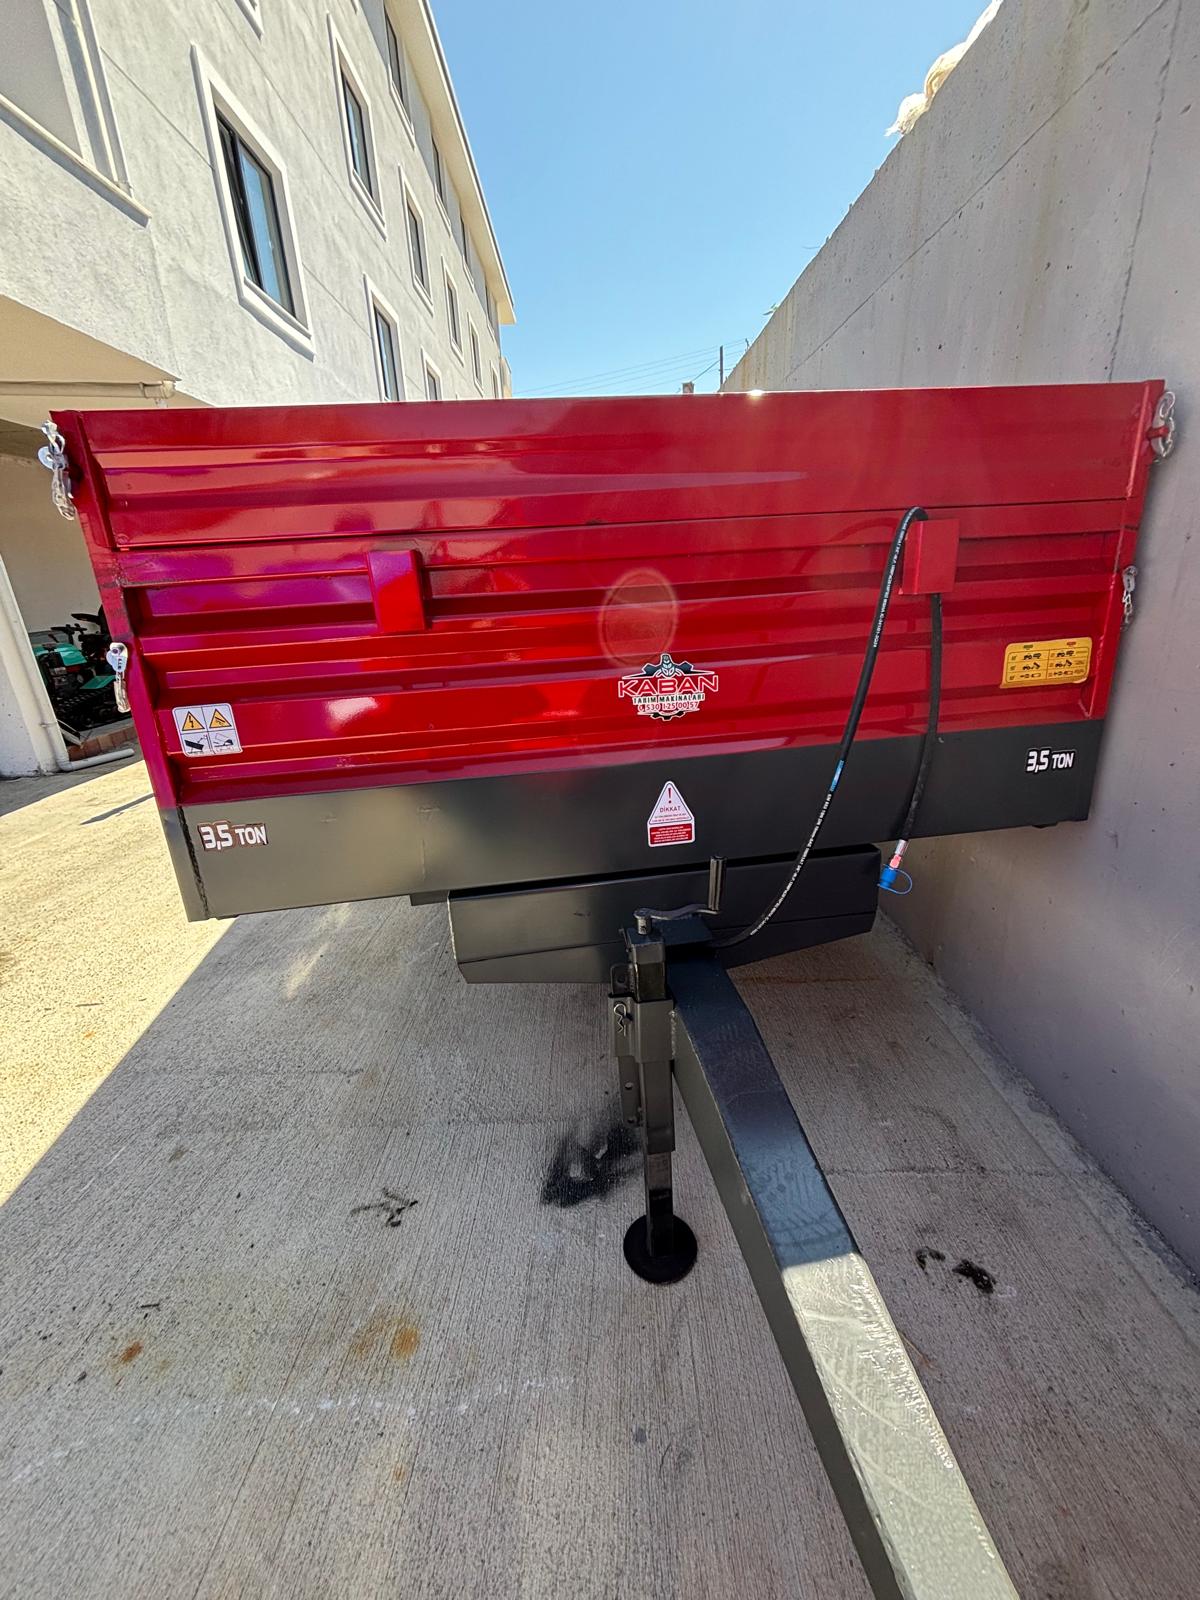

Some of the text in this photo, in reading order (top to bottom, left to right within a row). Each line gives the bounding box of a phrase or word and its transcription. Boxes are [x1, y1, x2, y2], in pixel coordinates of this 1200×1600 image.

[618, 675, 719, 698] KABAN
[632, 696, 657, 705] TARIM
[1026, 749, 1075, 773] 3,5 TON
[659, 805, 681, 813] DİKKAT
[200, 824, 268, 850] 3,5 TON
